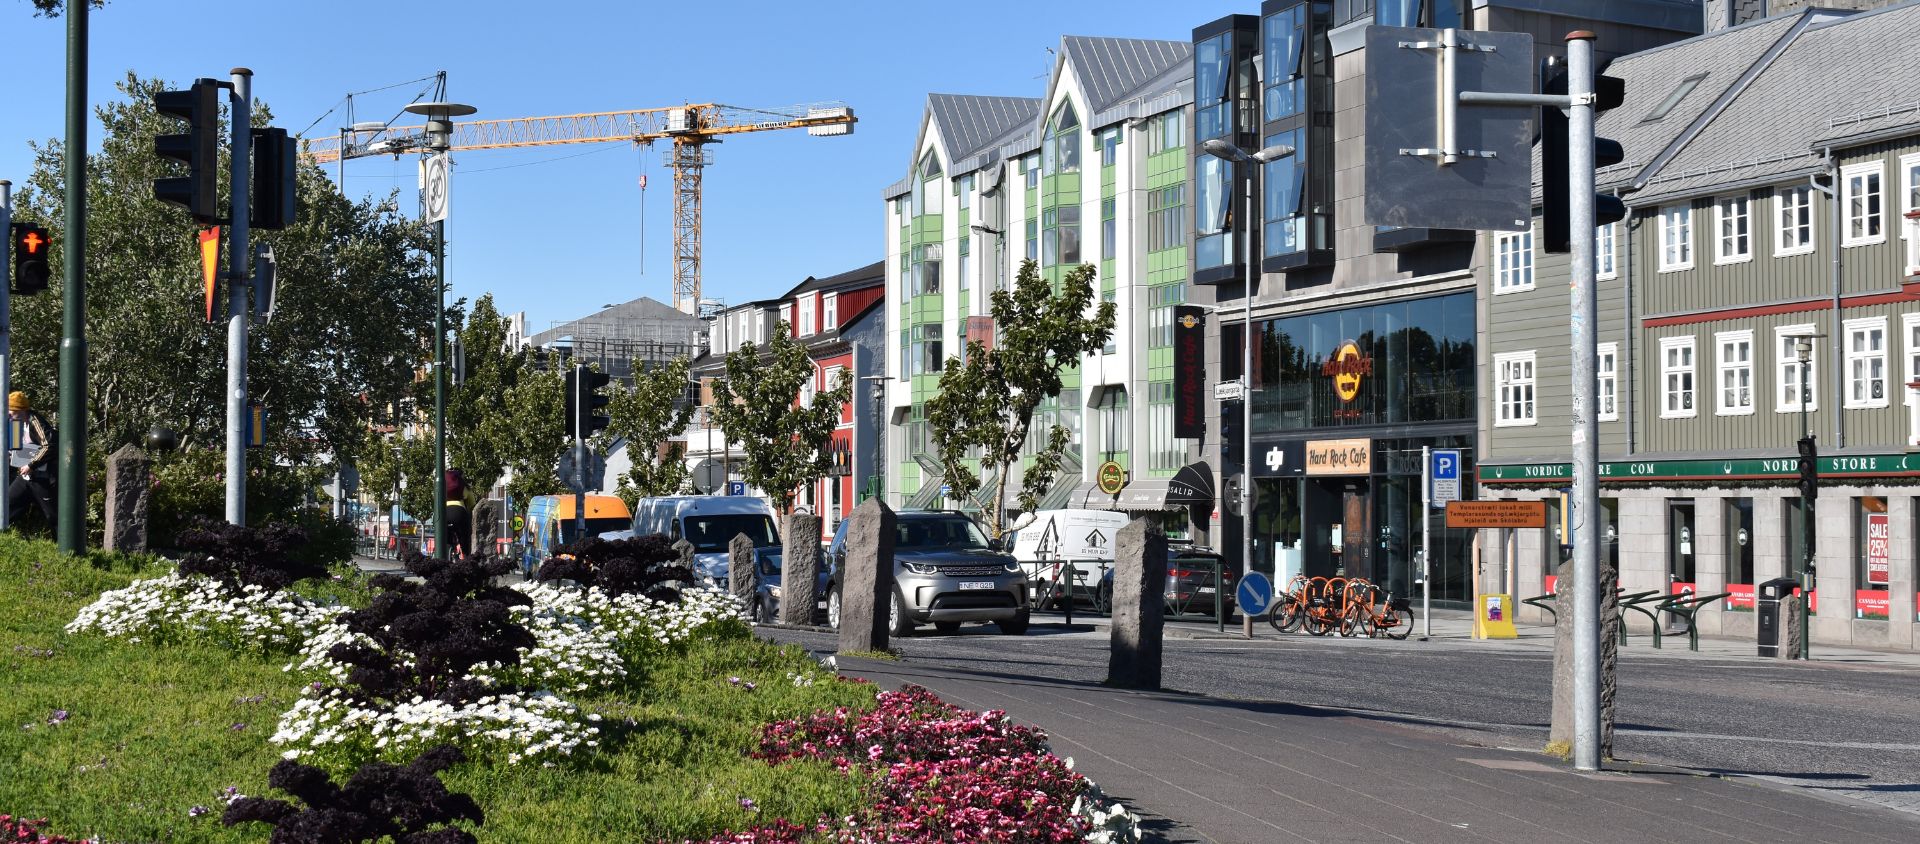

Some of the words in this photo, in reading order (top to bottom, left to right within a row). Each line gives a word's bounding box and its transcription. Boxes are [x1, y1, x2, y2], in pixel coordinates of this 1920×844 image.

[1309, 448, 1328, 465] Hard
[1330, 448, 1347, 468] Rock
[1350, 447, 1367, 467] Cafe
[1763, 459, 1799, 472] NORD
[1833, 457, 1877, 471] STORE
[1440, 457, 1451, 475] P
[1525, 465, 1564, 477] NORDIC
[1630, 463, 1654, 475] COM
[734, 484, 742, 494] P
[1870, 524, 1888, 538] SALE
[1870, 540, 1888, 557] 25%
